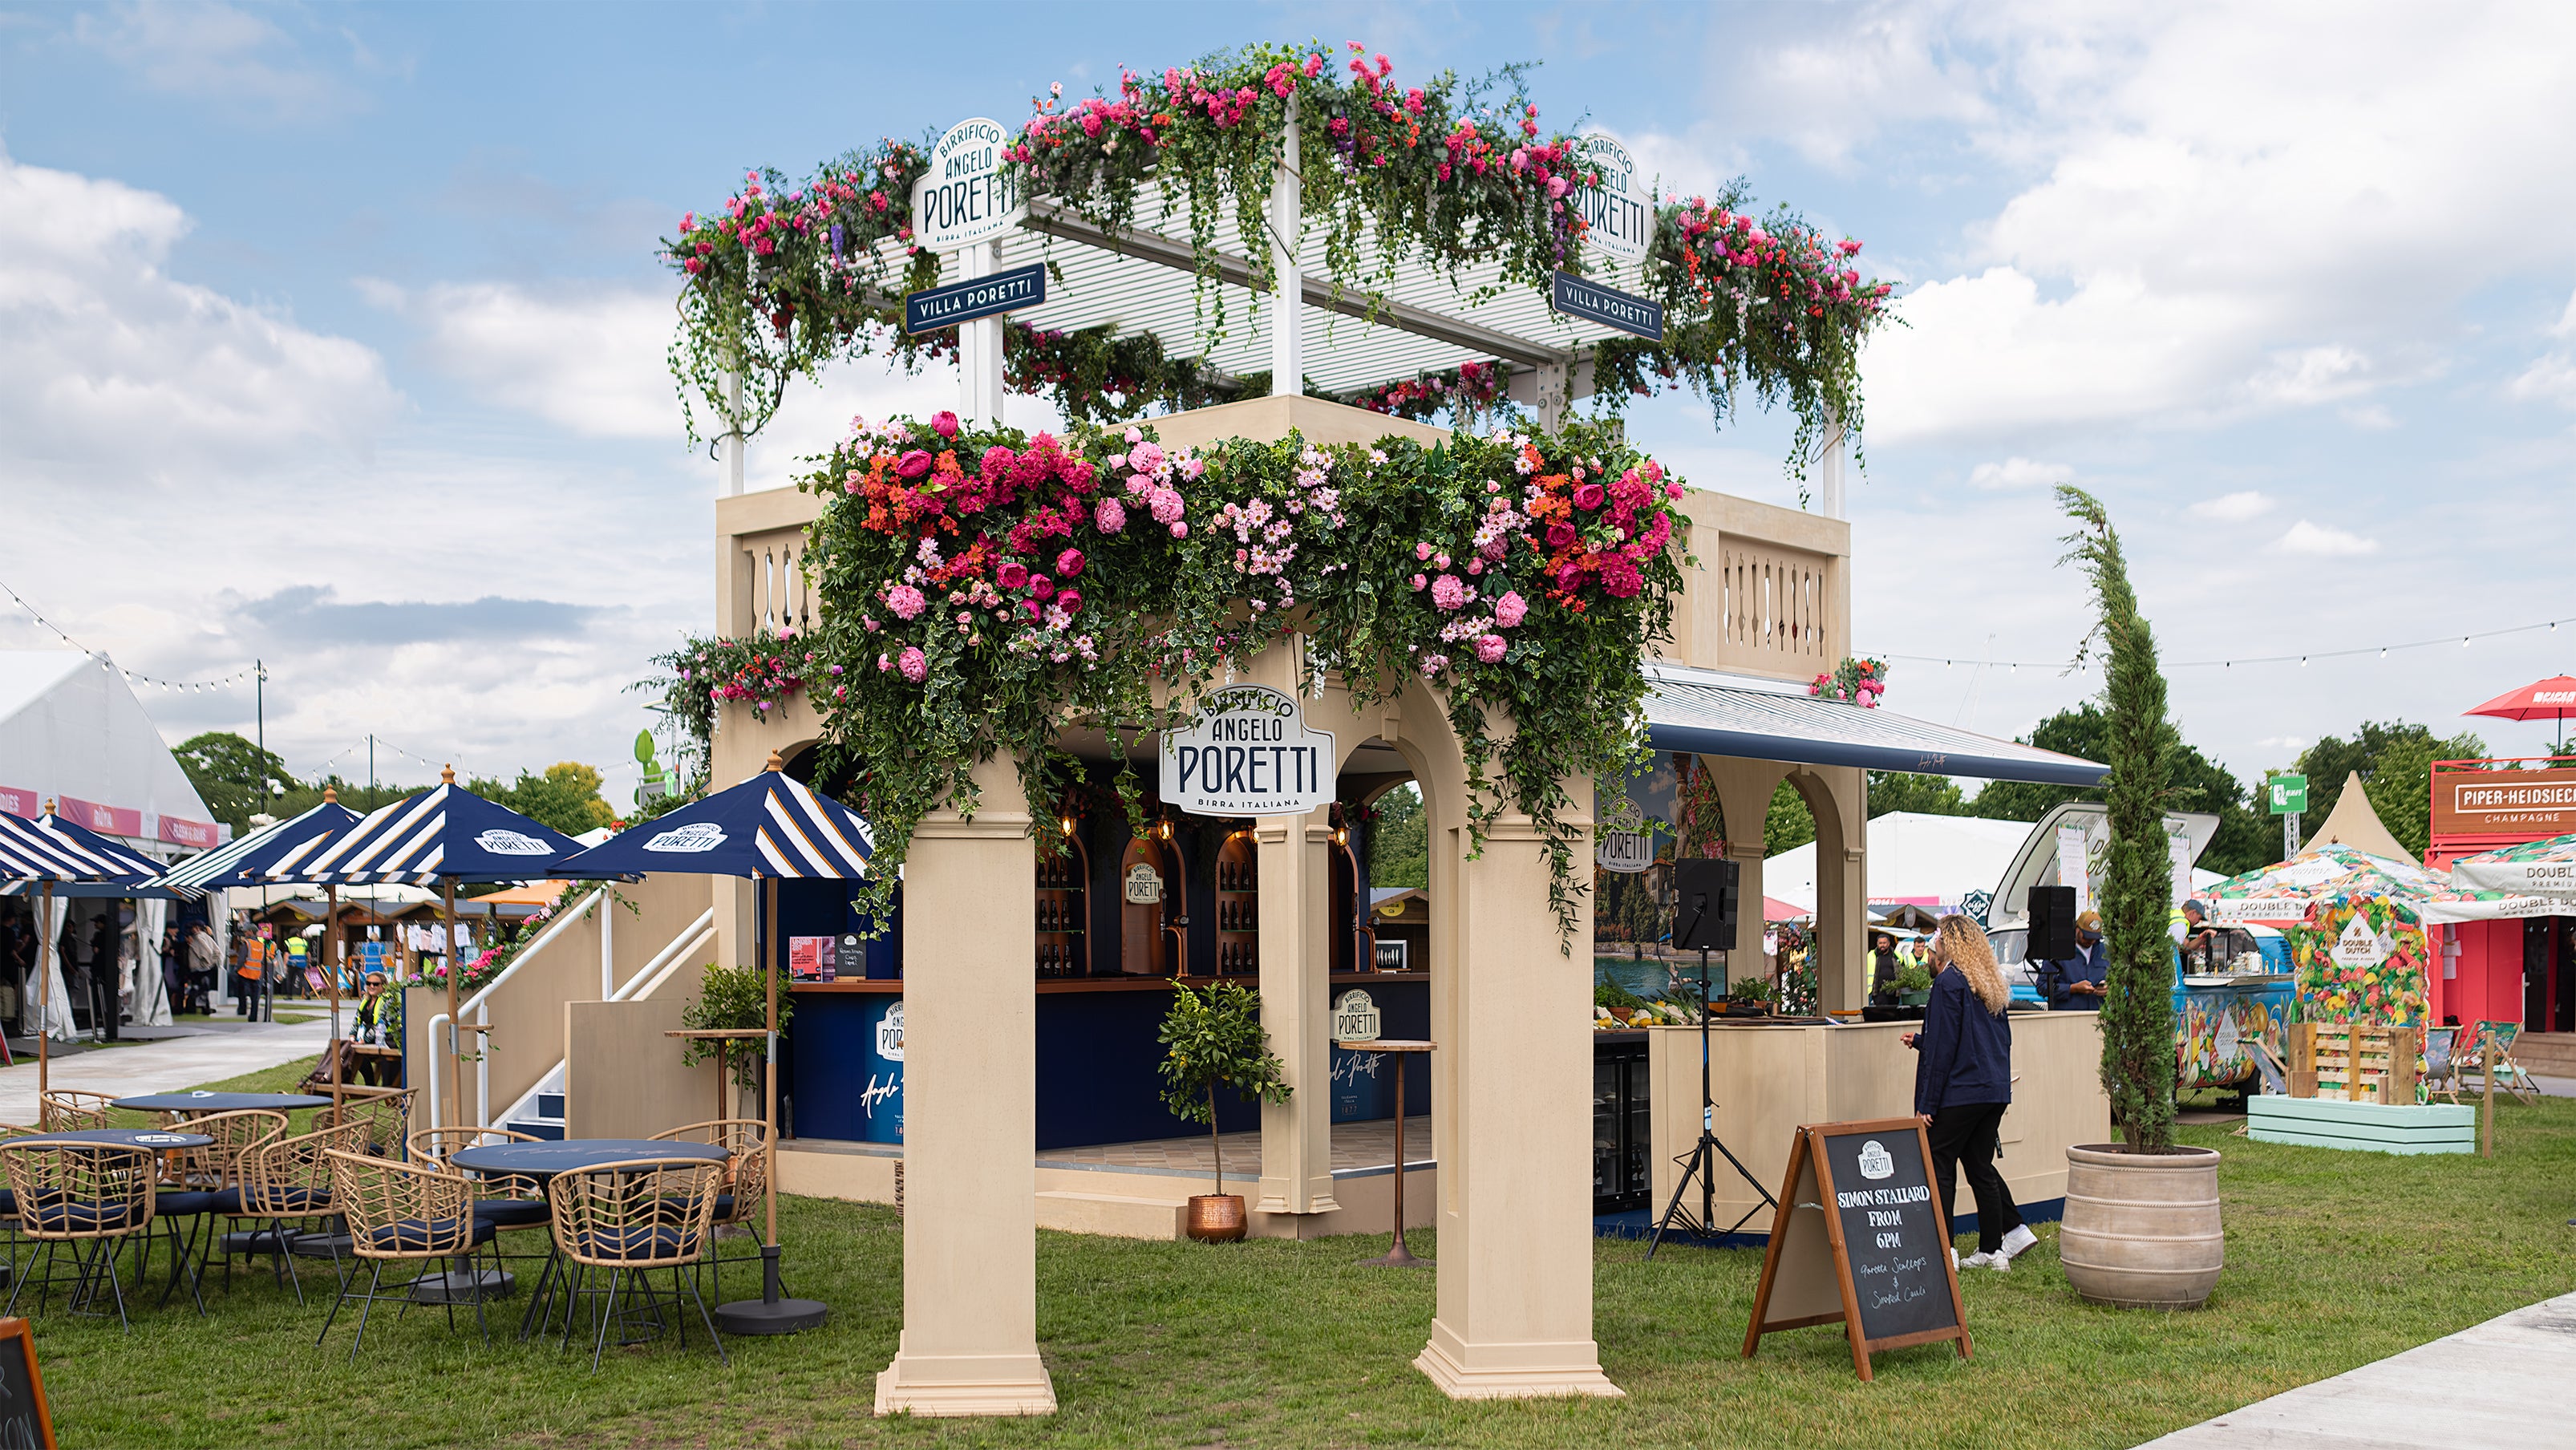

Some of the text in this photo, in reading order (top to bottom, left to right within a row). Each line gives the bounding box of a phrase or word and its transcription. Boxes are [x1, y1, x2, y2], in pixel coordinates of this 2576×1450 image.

[939, 124, 1000, 158] BIRRIFICIO
[946, 147, 992, 180] ANGELO
[1586, 140, 1633, 174] BIRRIFICIO
[1604, 165, 1627, 193] GELO
[924, 172, 1015, 234] PORETTI
[936, 220, 1004, 242] BIRRA ITALIANA
[1605, 240, 1636, 254] ITALIANA
[920, 278, 1031, 318] VILLA PORETTI
[1565, 286, 1653, 326] VILLA PORETTI
[1212, 718, 1282, 742] ANGELO
[1179, 746, 1317, 794] PORETTI
[1198, 798, 1300, 808] BIRRA ITALIANA
[2485, 812, 2560, 824] CHAMPAGNE
[652, 836, 716, 848] PORETTI
[1603, 832, 1646, 860] PORETTI
[2526, 867, 2576, 878] DOUBL
[1128, 881, 1160, 897] PORETTI
[2240, 902, 2291, 912] DOUBLE
[2498, 897, 2554, 911] DOUBLE
[2343, 939, 2372, 947] DOUBLE
[1345, 991, 1370, 1002] BIRRIFICIO
[1347, 1002, 1367, 1014] ANGELO
[1339, 1014, 1376, 1035] PORETTI
[1862, 1157, 1890, 1173] PORETTI
[1837, 1185, 1930, 1209] SIMON STALLARD
[1867, 1209, 1902, 1227] FROM
[1876, 1232, 1902, 1249] 6PM
